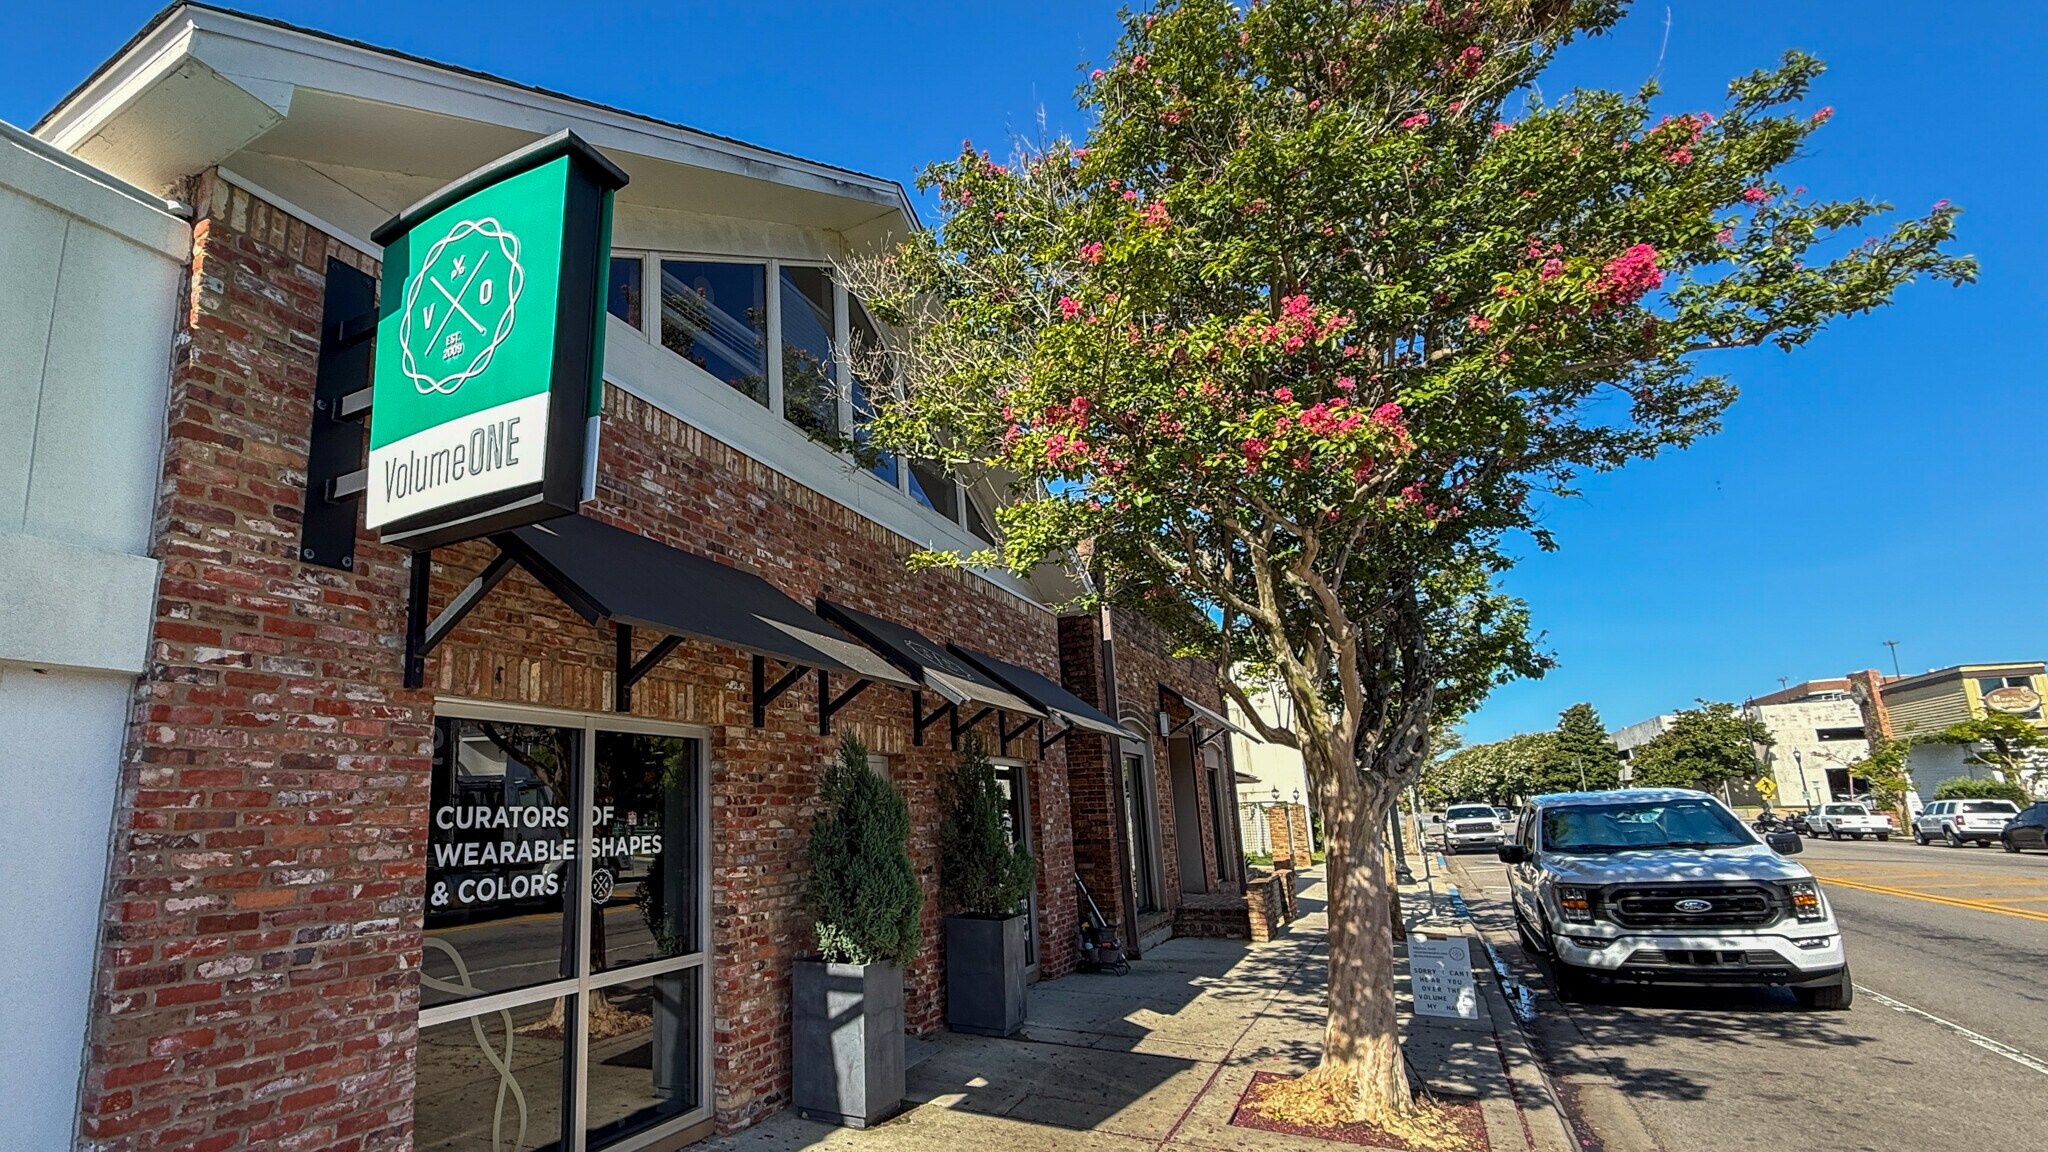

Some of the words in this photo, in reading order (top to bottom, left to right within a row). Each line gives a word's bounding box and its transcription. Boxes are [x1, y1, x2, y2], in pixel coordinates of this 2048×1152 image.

[423, 303, 436, 330] V
[385, 416, 521, 503] VolumeONE
[436, 806, 569, 829] CURATORS
[434, 839, 576, 867] WEARABLE
[592, 835, 662, 857] SHAPES
[431, 881, 449, 906] &
[458, 873, 559, 903] COLORS
[1413, 967, 1436, 975] SORRY
[1418, 994, 1447, 1002] VOLUME
